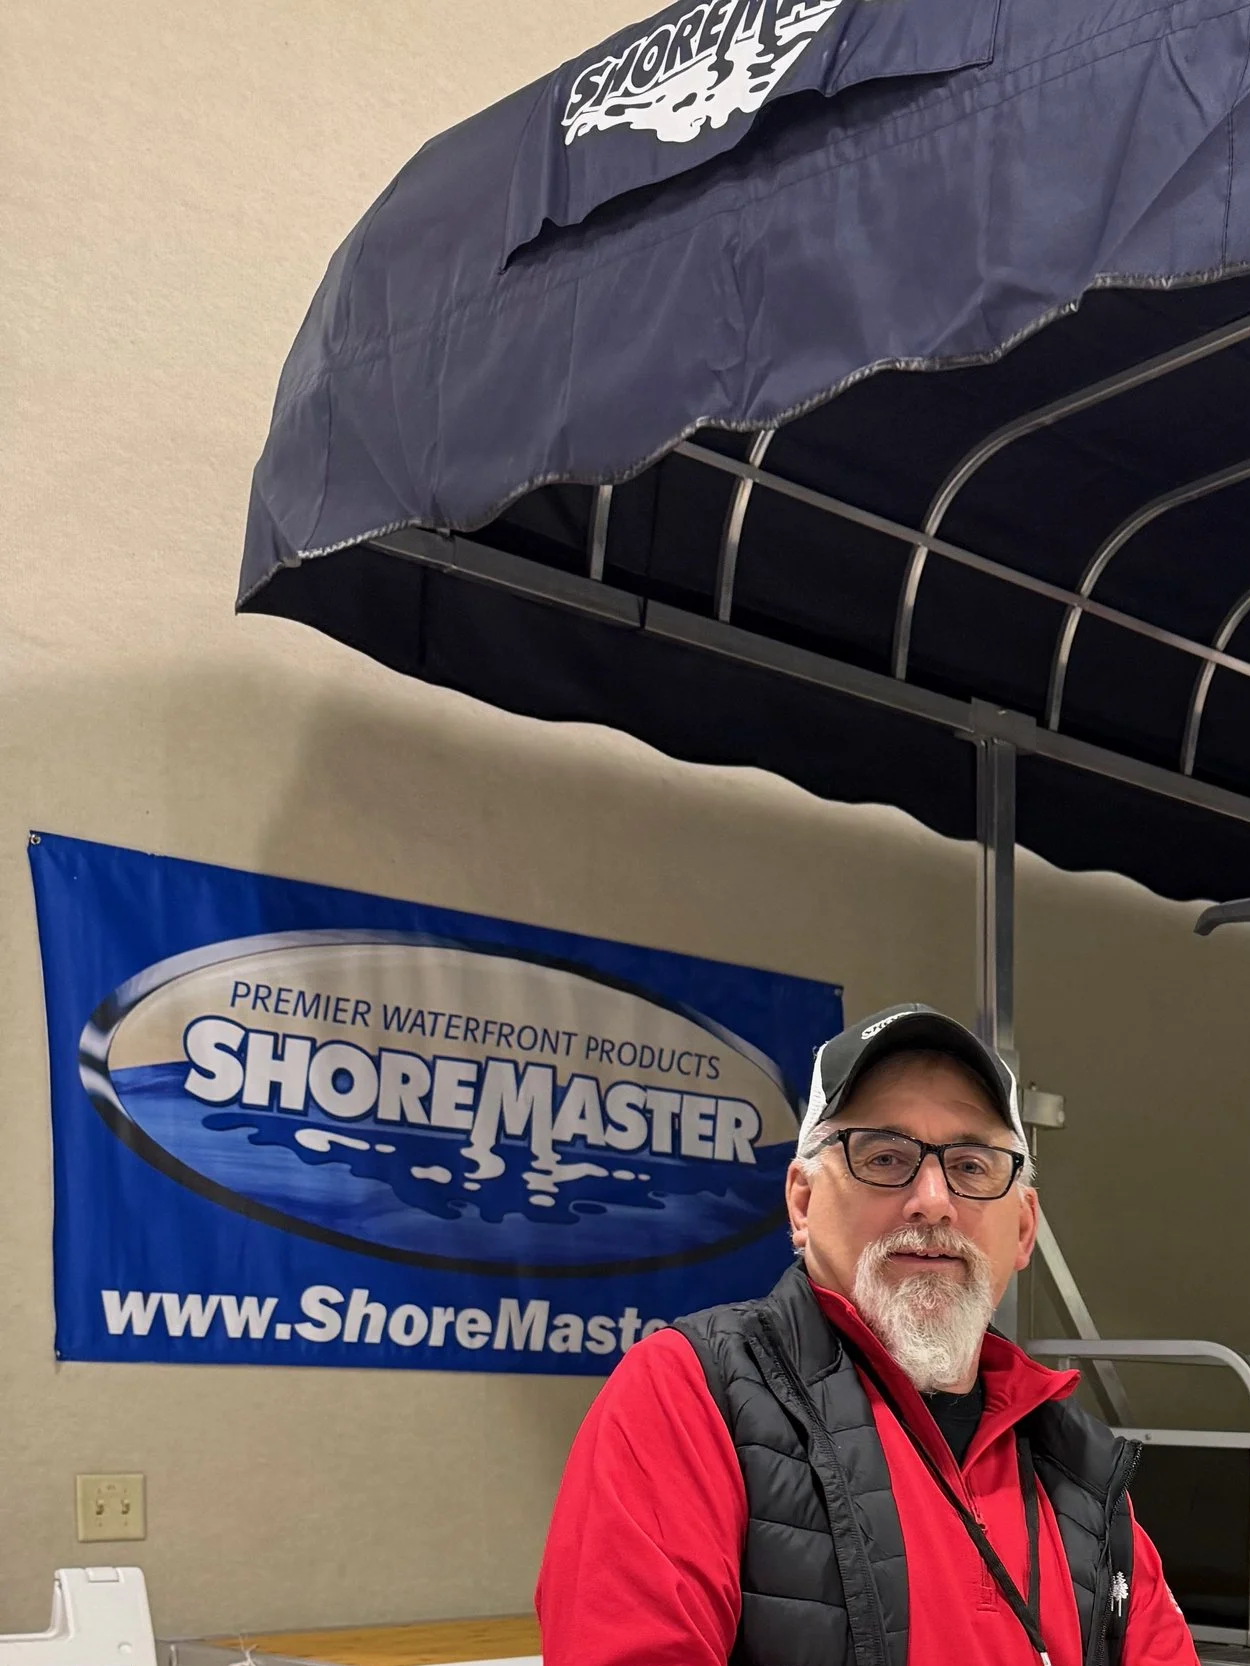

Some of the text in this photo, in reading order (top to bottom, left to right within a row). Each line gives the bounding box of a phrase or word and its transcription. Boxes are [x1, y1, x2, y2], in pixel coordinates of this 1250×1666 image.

[183, 1014, 758, 1180] SHOREMASTER
[229, 980, 720, 1081] PREMIER WATERFRONT PRODUCTS
